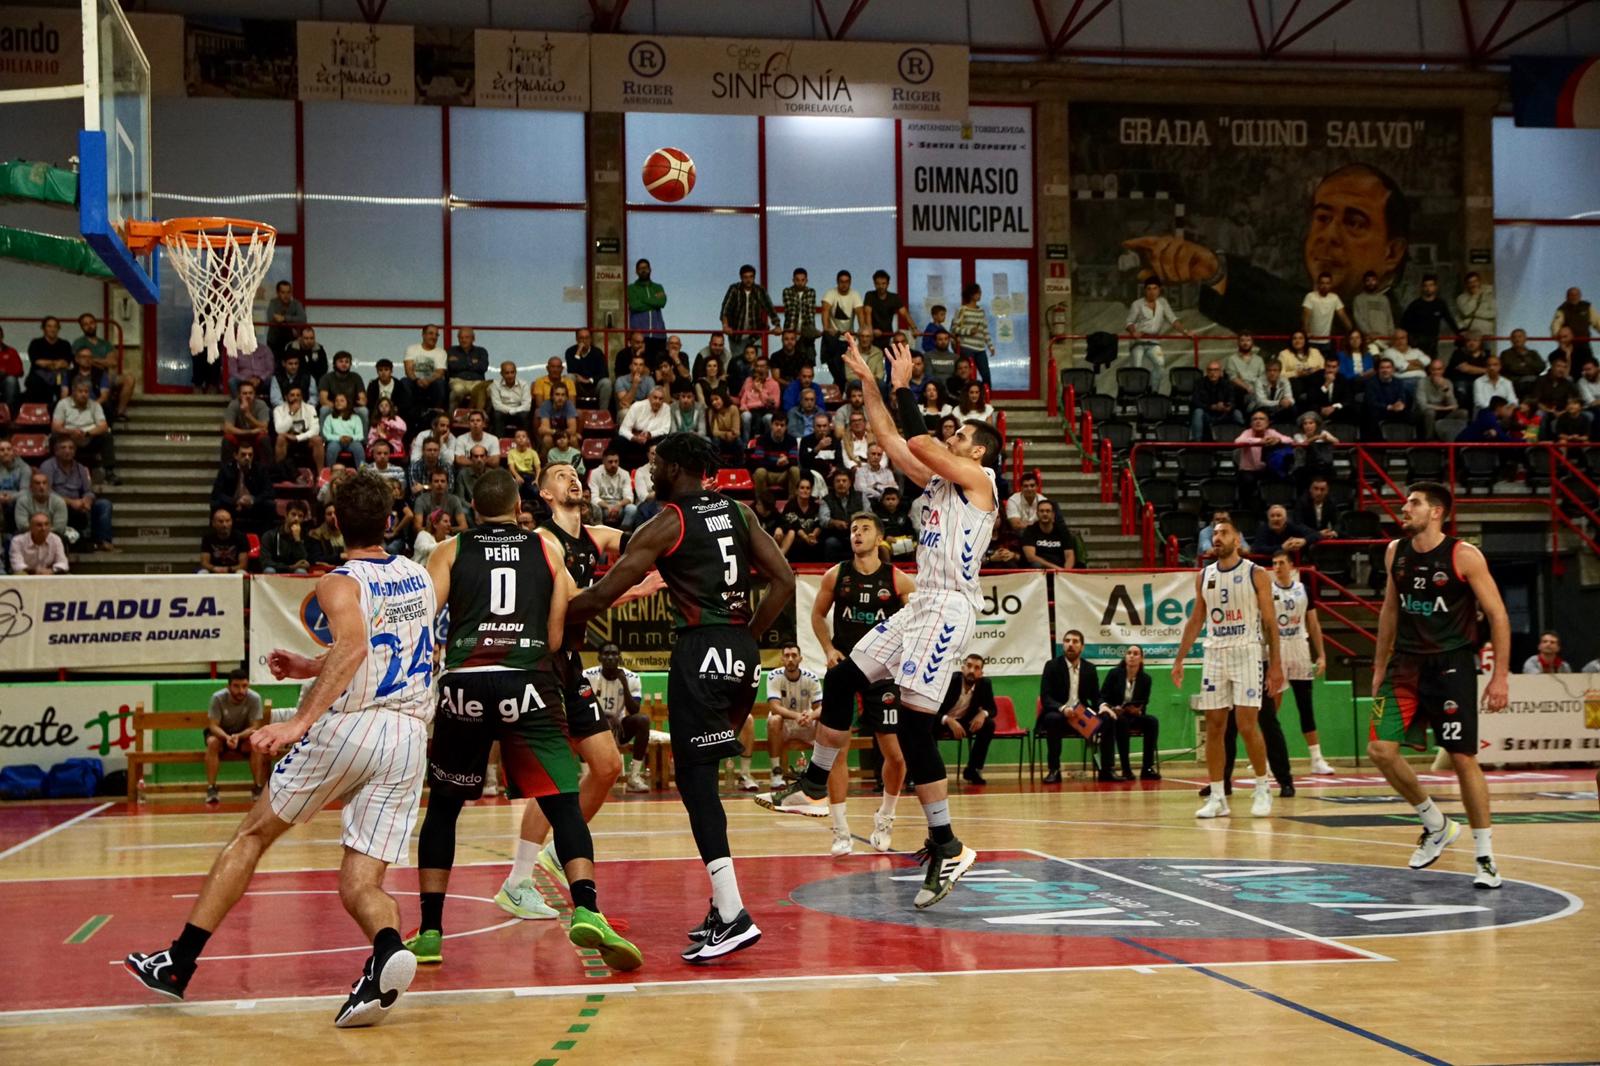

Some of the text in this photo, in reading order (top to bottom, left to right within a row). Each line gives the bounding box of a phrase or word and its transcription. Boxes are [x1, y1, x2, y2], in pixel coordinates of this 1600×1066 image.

[712, 69, 852, 101] SINFONÍA
[785, 103, 854, 113] TORRELAVEGA
[1120, 117, 1211, 146] GRADA
[914, 165, 1018, 194] GIMNASIO
[912, 203, 1030, 232] MUNICIPAL
[484, 544, 520, 561] PEÑA
[717, 536, 738, 586] 5
[490, 567, 516, 615] 0
[1413, 577, 1427, 590] 22
[859, 592, 870, 603] 10
[1220, 588, 1229, 604] 3
[42, 596, 225, 623] BILADU S.A.
[1225, 609, 1243, 621] HLA
[478, 622, 524, 632] BILADU
[1100, 627, 1181, 637] es tu derecho
[48, 628, 221, 645] SANTANDER ADUANAS
[370, 625, 433, 698] 24
[882, 709, 898, 725] 10
[1442, 721, 1462, 740] 22
[1503, 738, 1572, 750] SENTIR
